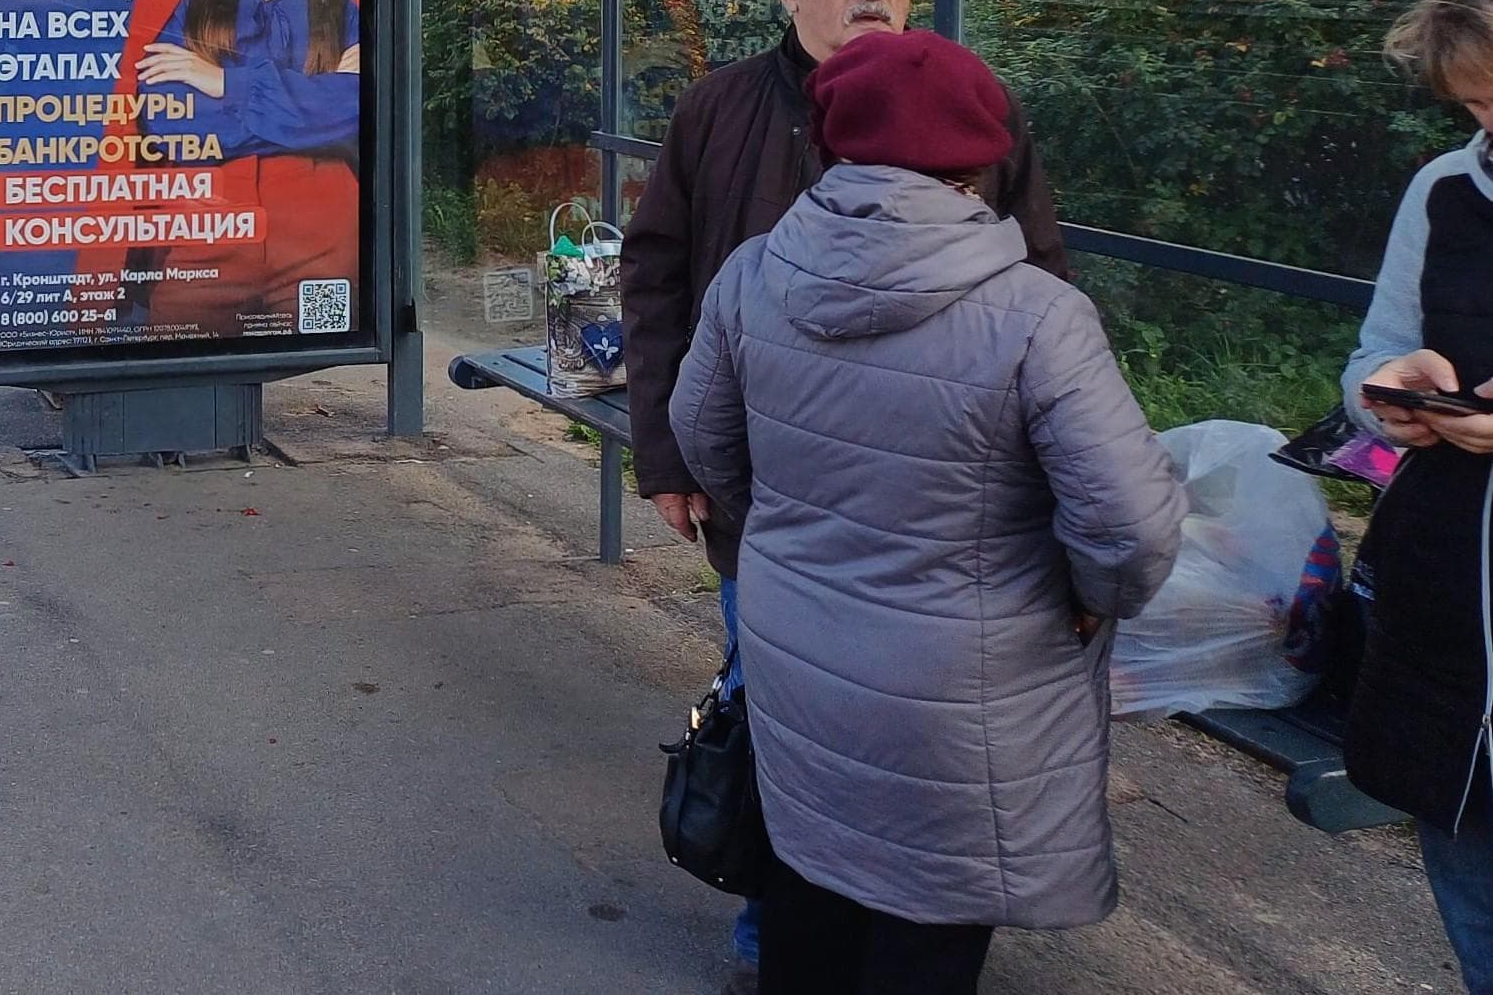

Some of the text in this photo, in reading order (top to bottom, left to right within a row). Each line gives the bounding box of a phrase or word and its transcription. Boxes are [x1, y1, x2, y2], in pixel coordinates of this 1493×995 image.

[47, 10, 130, 39] ВСЕХ
[5, 172, 212, 204] БЕСПЛАТНАЯ
[5, 212, 255, 245] КОНСУЛЬТАЦИЯ
[0, 267, 219, 289] г. Кронштадт, ул. Карла Маркса
[0, 287, 126, 305] 6/29 лит А, этаж 2
[0, 308, 117, 327] 8 (800) 600 25-61
[0, 331, 18, 339] ООО
